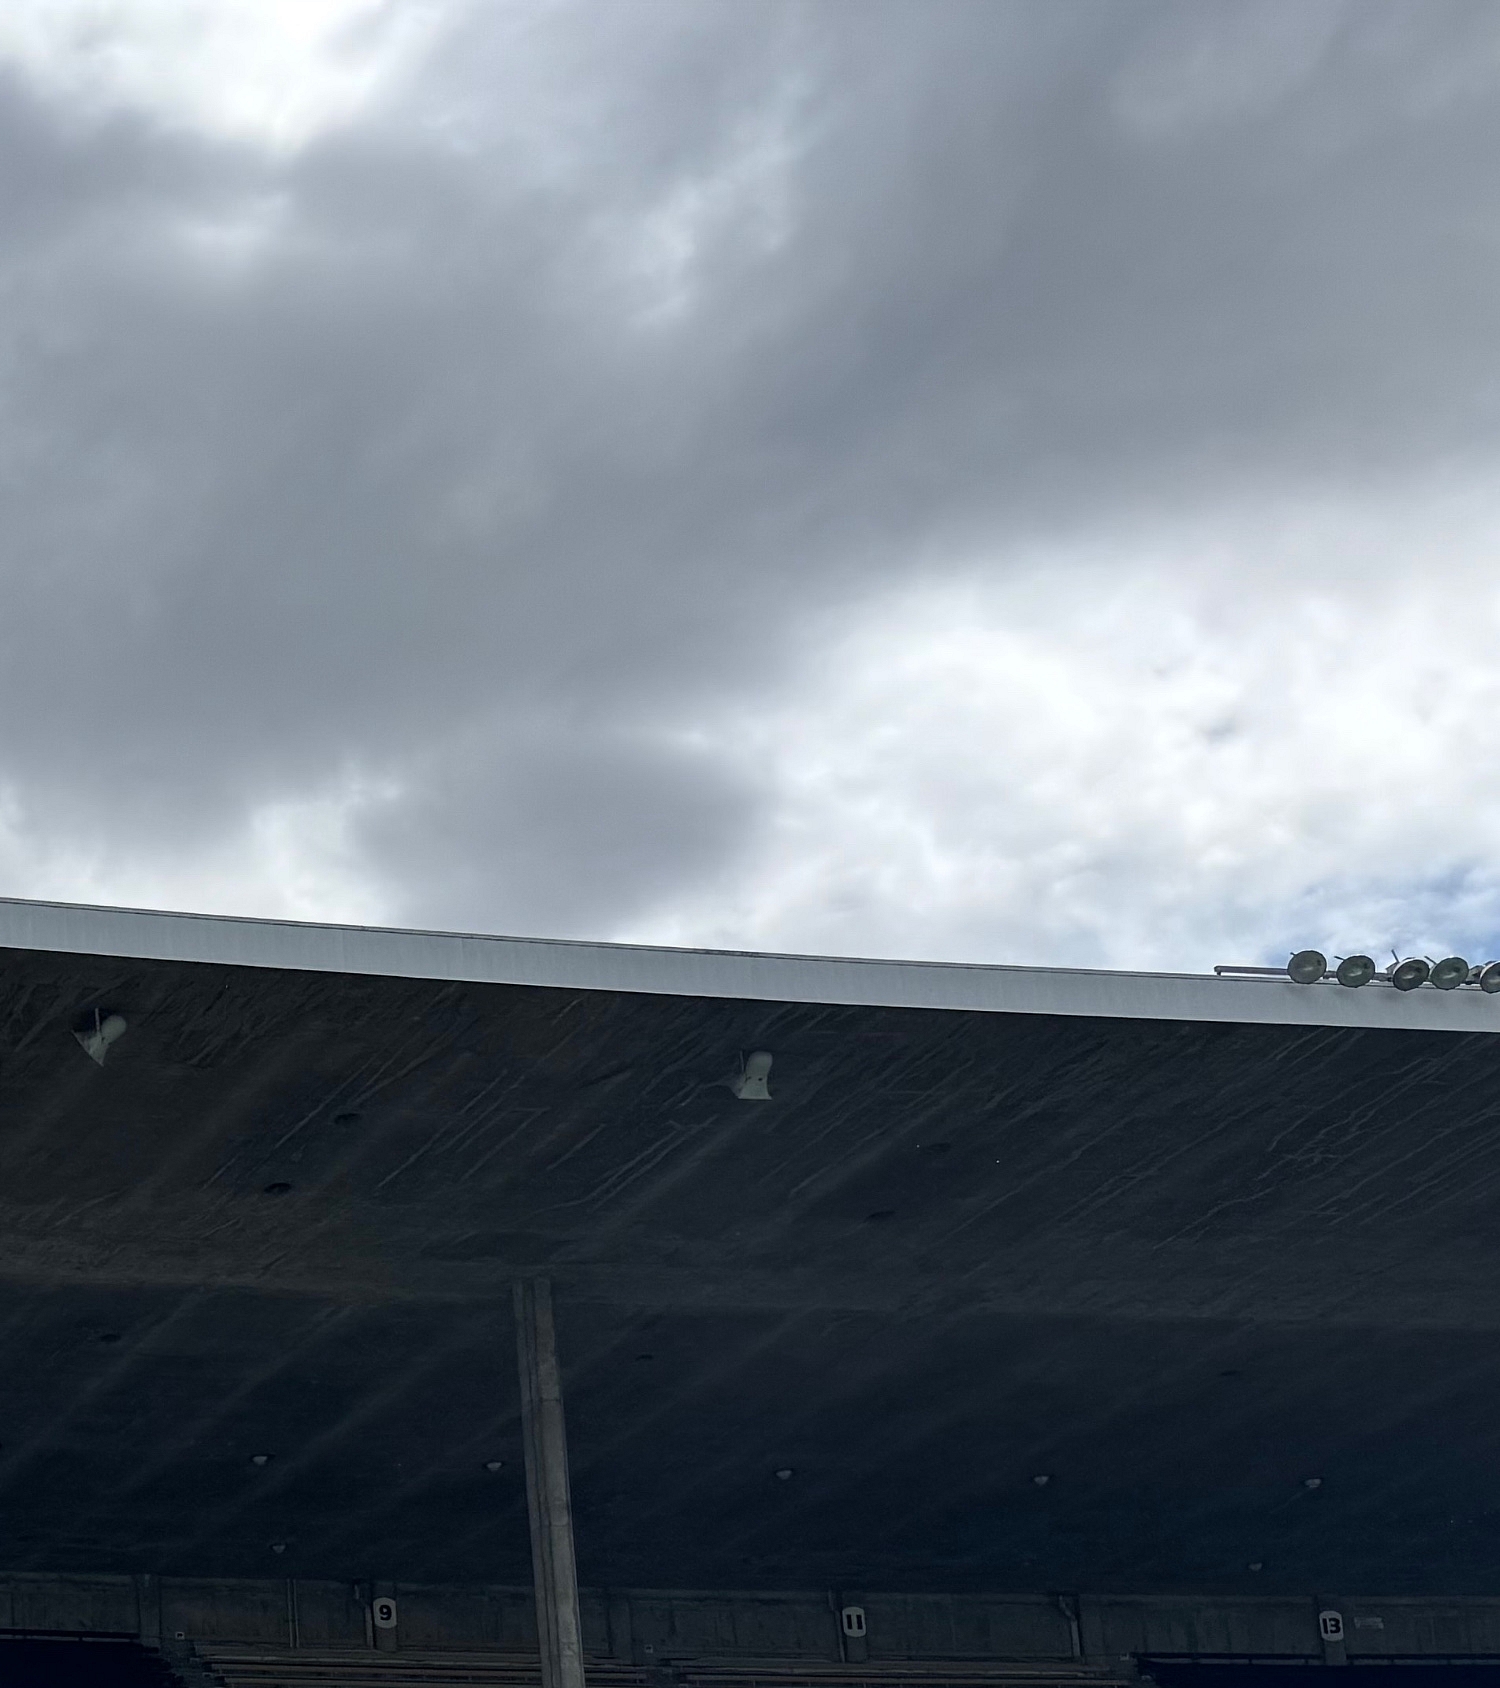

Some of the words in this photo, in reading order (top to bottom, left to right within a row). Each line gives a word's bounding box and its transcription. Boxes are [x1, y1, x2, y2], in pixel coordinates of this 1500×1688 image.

[379, 1604, 392, 1621] 9
[846, 1614, 863, 1630] 11
[1322, 1617, 1341, 1634] 13
